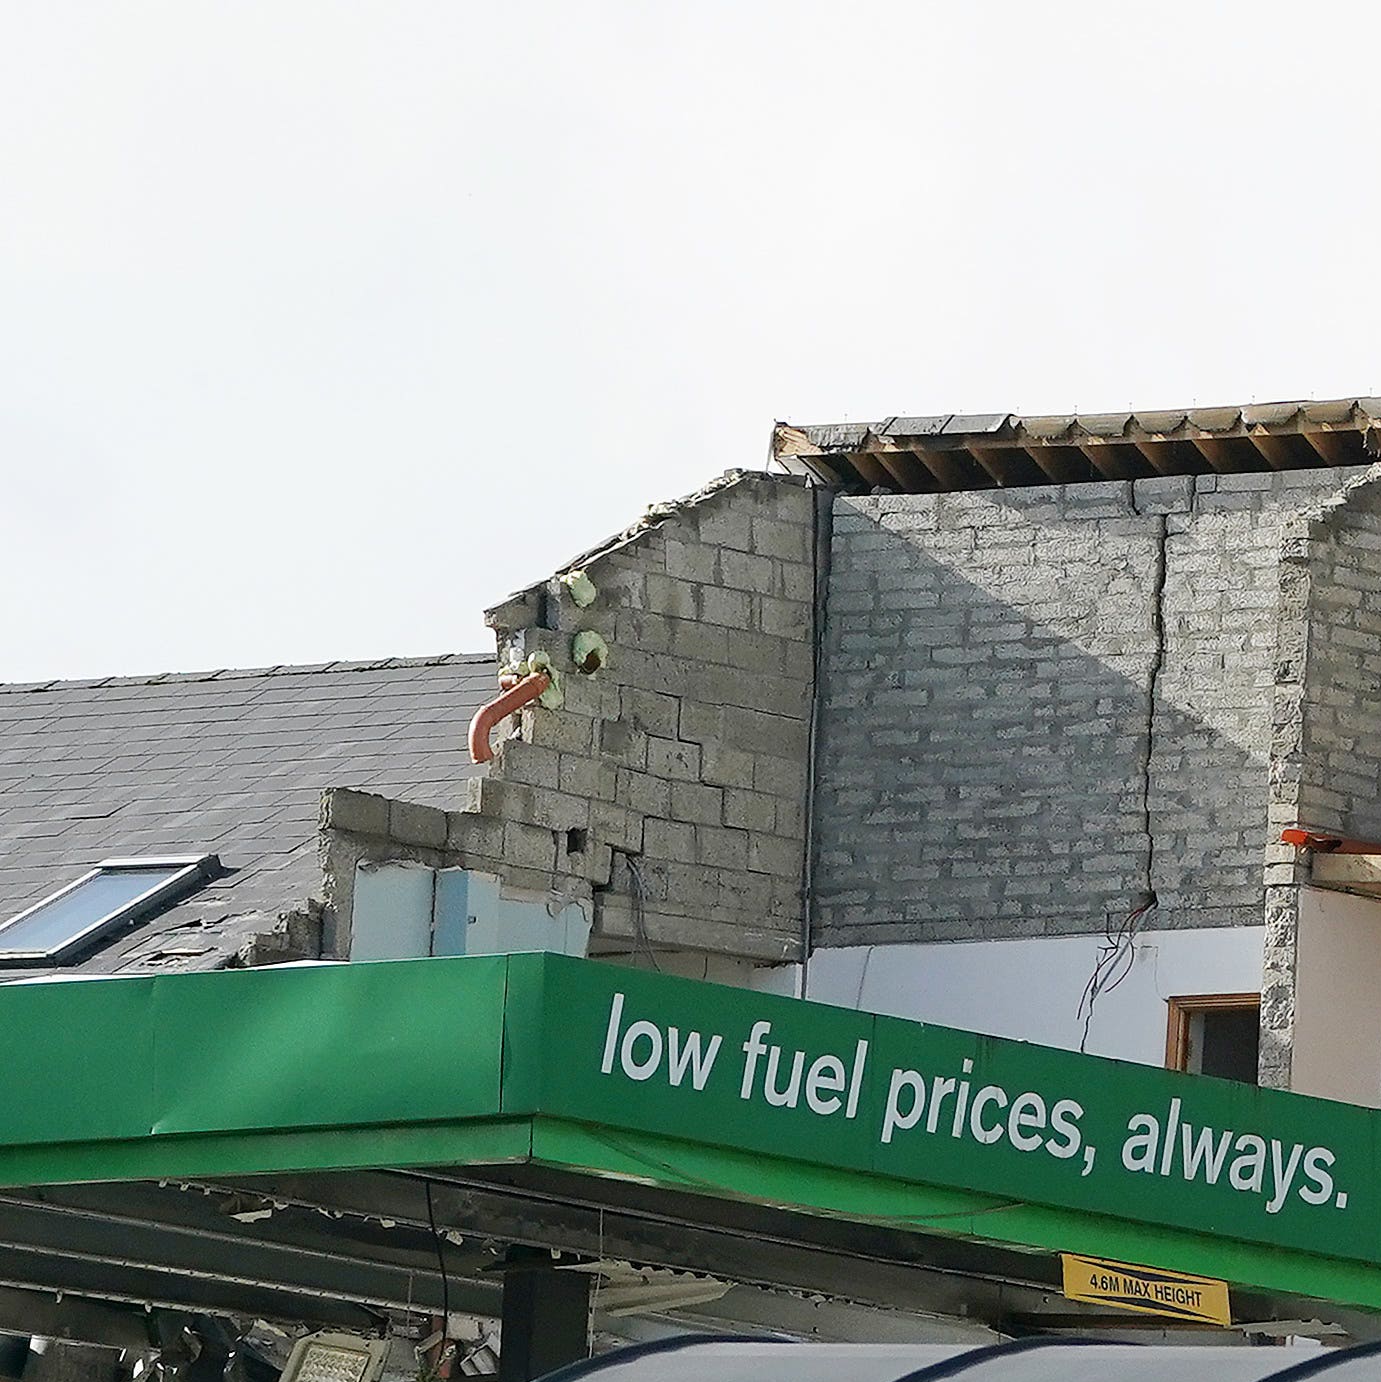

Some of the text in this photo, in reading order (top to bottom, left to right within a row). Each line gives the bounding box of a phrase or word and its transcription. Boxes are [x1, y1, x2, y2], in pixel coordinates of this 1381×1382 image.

[601, 993, 1348, 1214] low fuel prices, always.
[1090, 1273, 1202, 1307] 4.6M MAX HEIGHT
